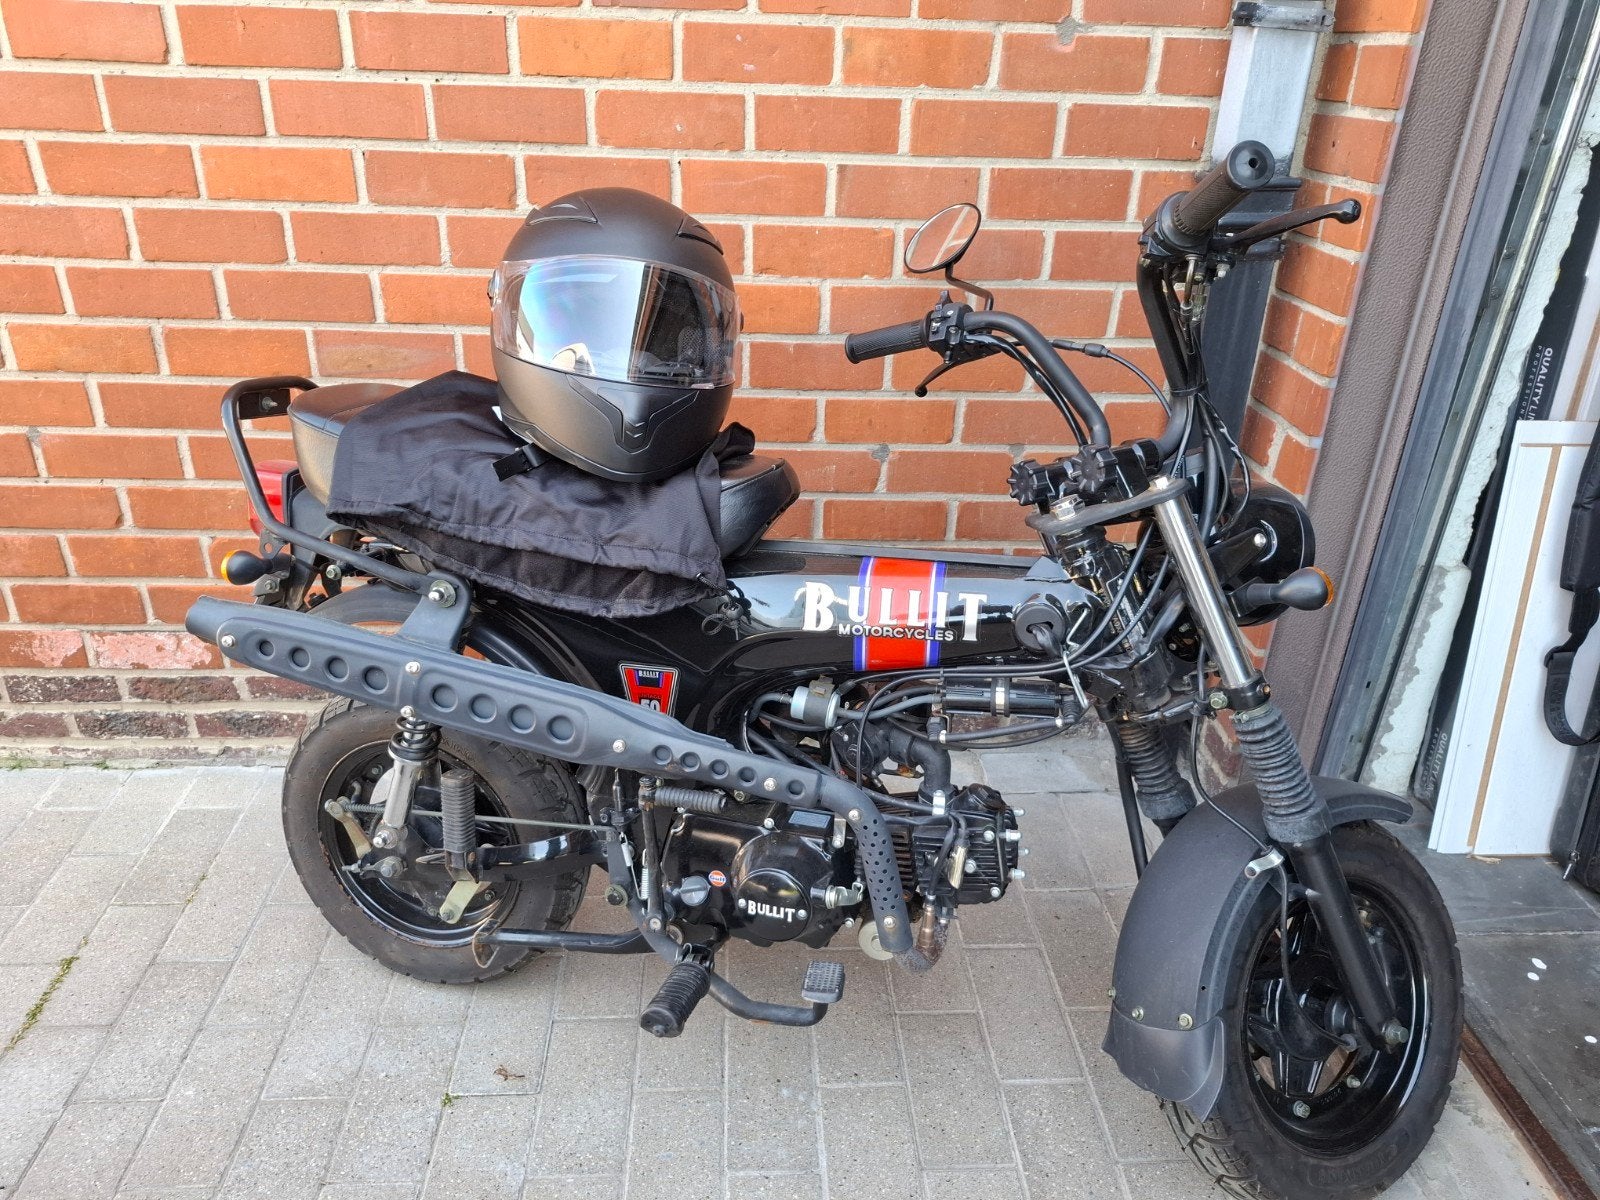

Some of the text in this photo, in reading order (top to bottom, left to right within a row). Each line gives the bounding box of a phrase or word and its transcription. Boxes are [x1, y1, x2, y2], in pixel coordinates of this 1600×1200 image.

[802, 581, 987, 642] BULLIT
[838, 623, 954, 641] MOTORCYCLES
[748, 900, 795, 922] BULLIT
